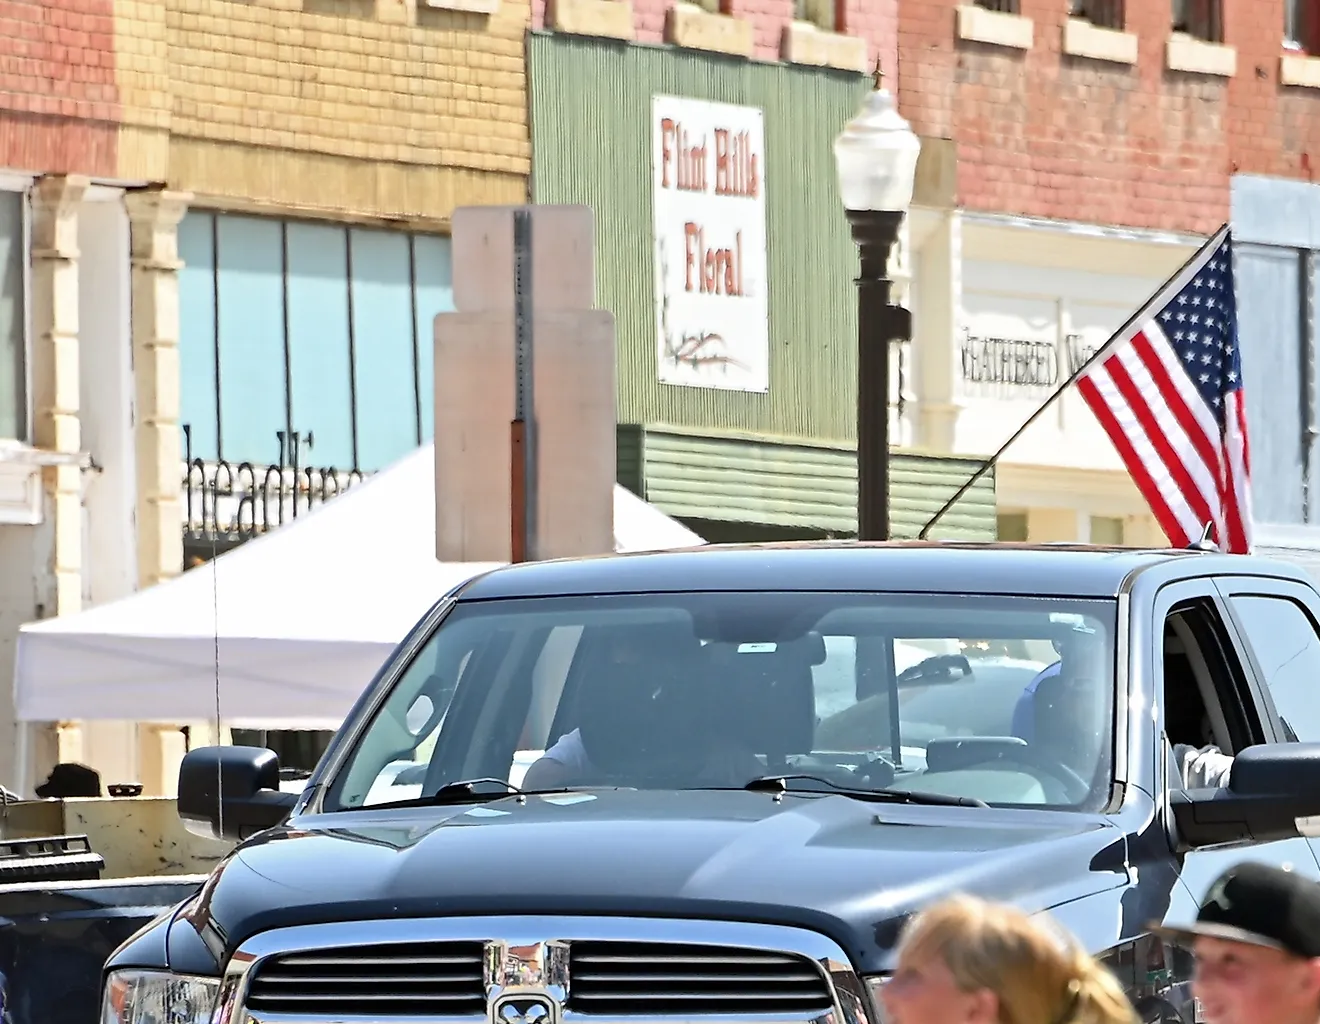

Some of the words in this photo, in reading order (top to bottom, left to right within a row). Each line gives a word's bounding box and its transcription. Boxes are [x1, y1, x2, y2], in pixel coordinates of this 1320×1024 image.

[660, 117, 708, 190] Flint
[714, 127, 760, 199] Hills
[683, 221, 744, 296] Floral
